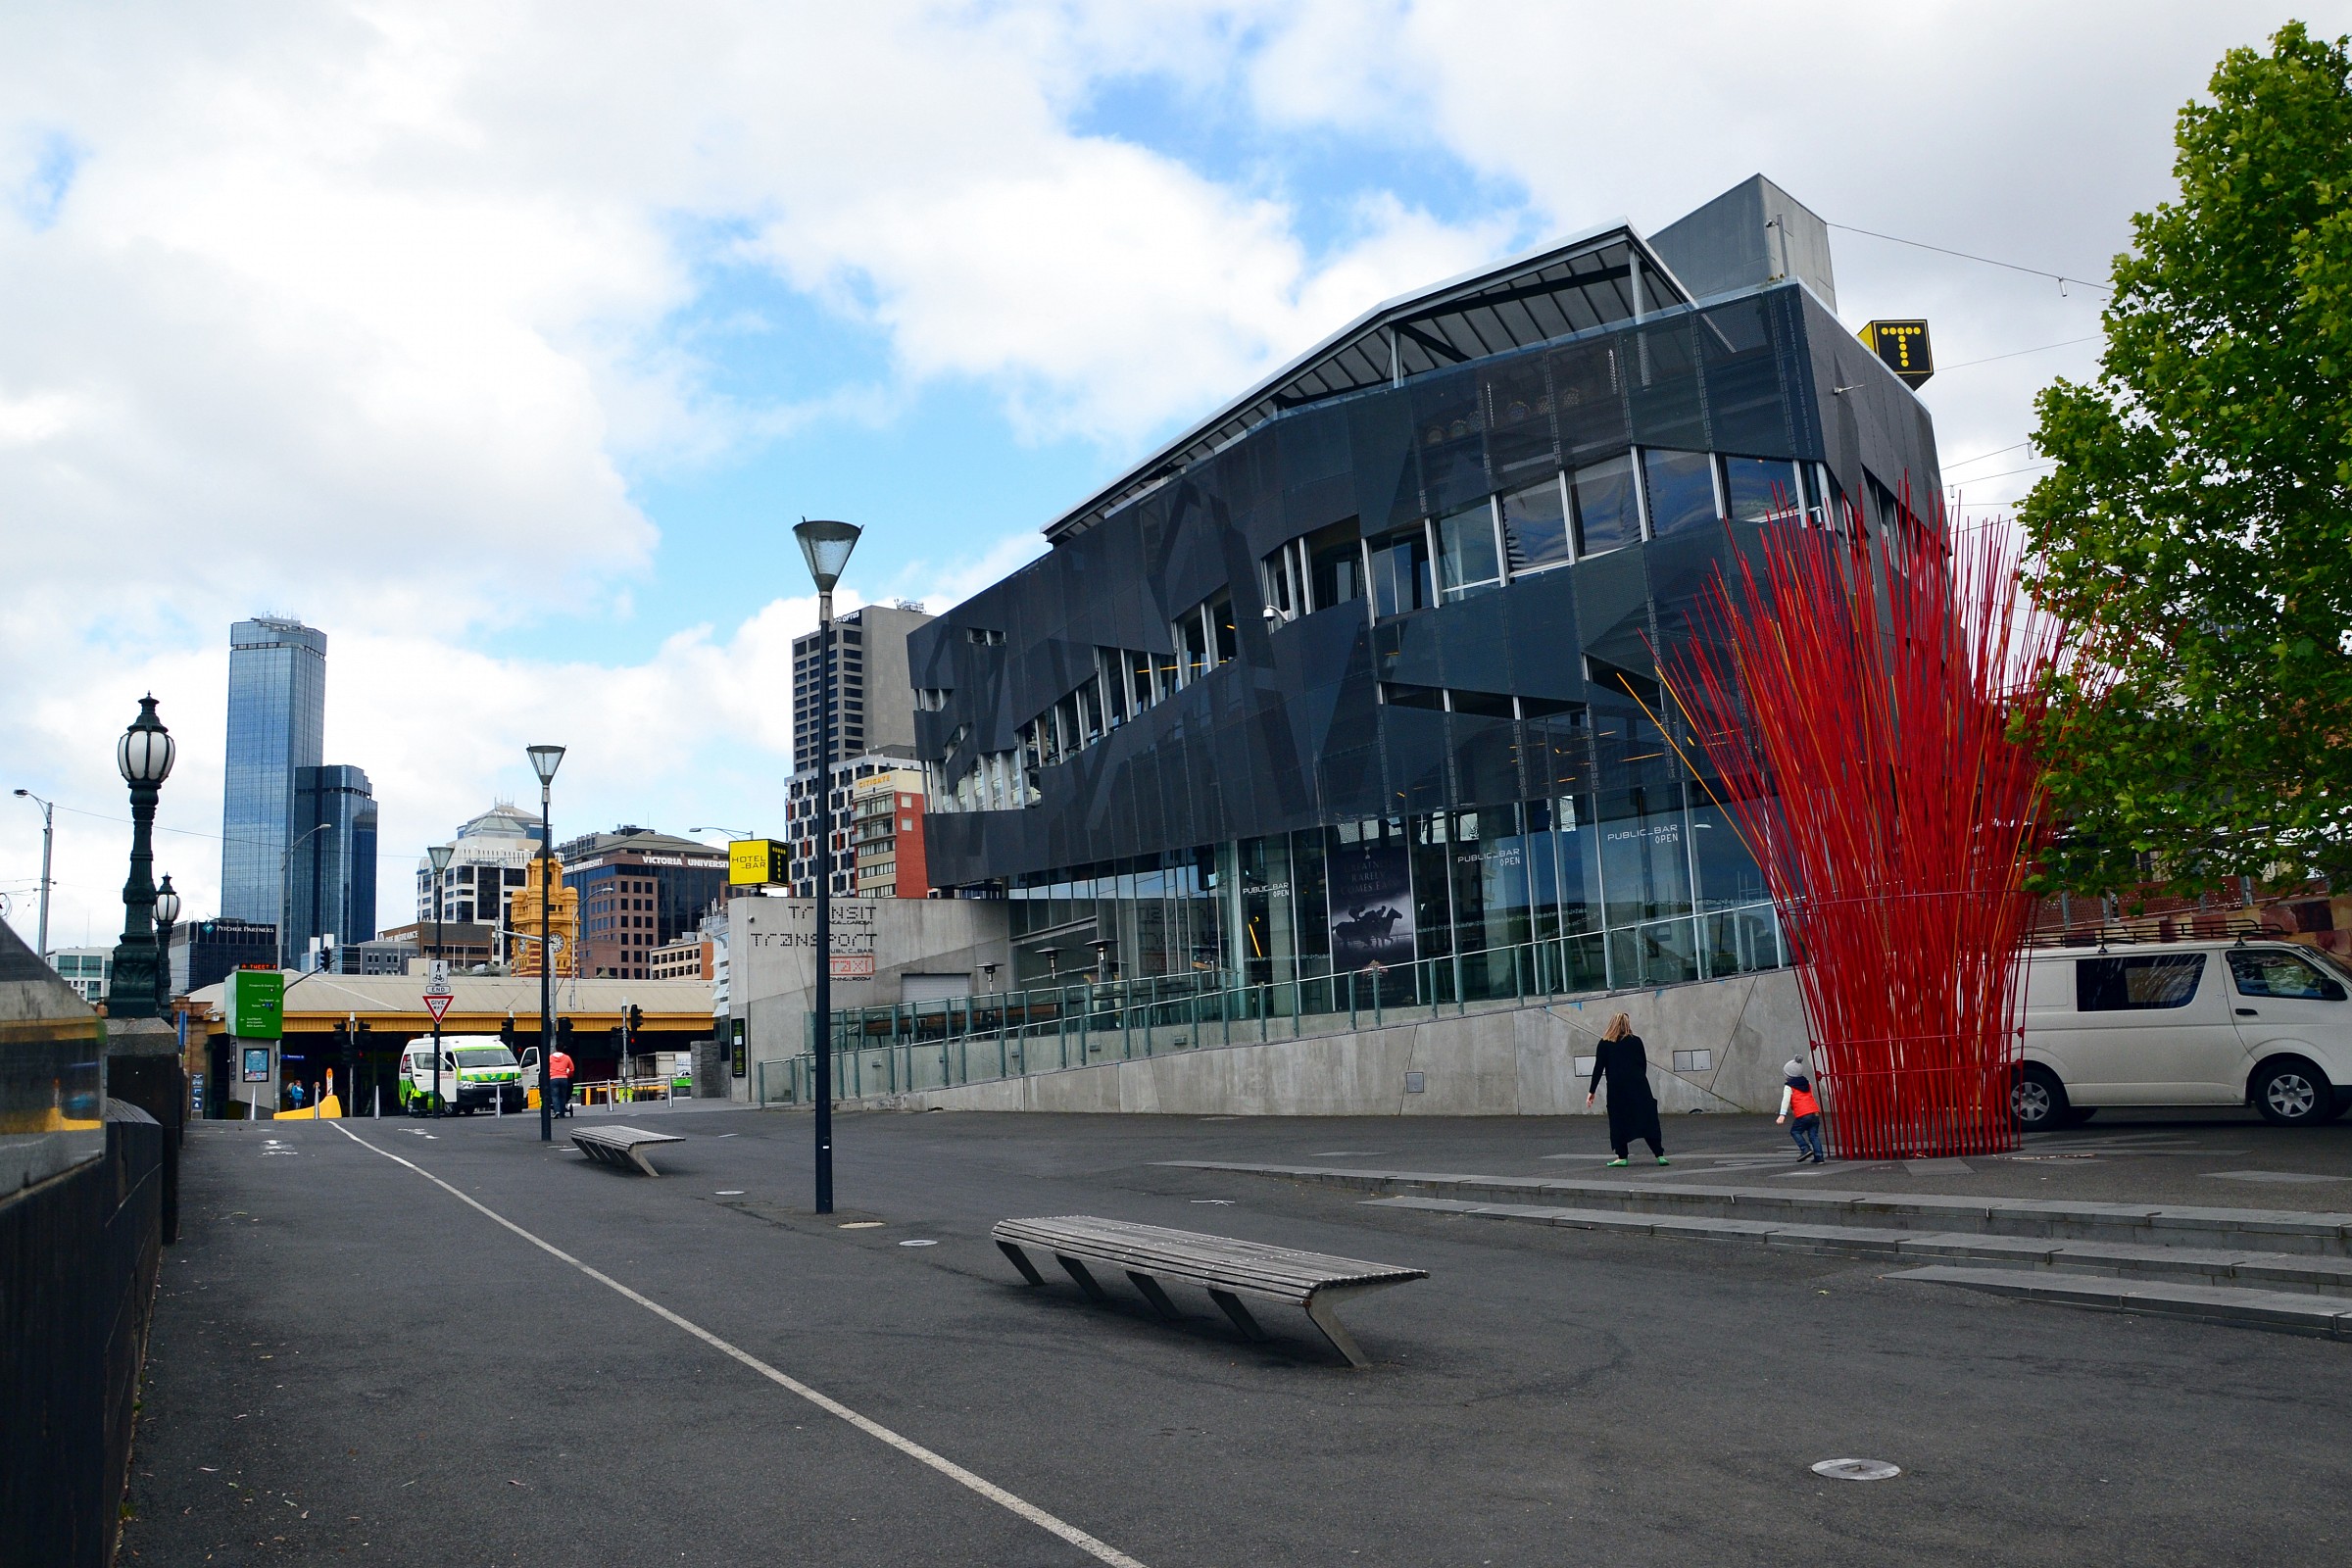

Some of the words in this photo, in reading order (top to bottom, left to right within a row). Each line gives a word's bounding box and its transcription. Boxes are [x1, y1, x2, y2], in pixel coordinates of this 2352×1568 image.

[1882, 327, 1921, 367] T
[859, 774, 891, 788] CITIGATE
[1654, 833, 1679, 844] OPEN
[642, 856, 683, 866] VICTORIA
[687, 858, 730, 869] UNIVERSIT
[1499, 857, 1521, 867] OPEN
